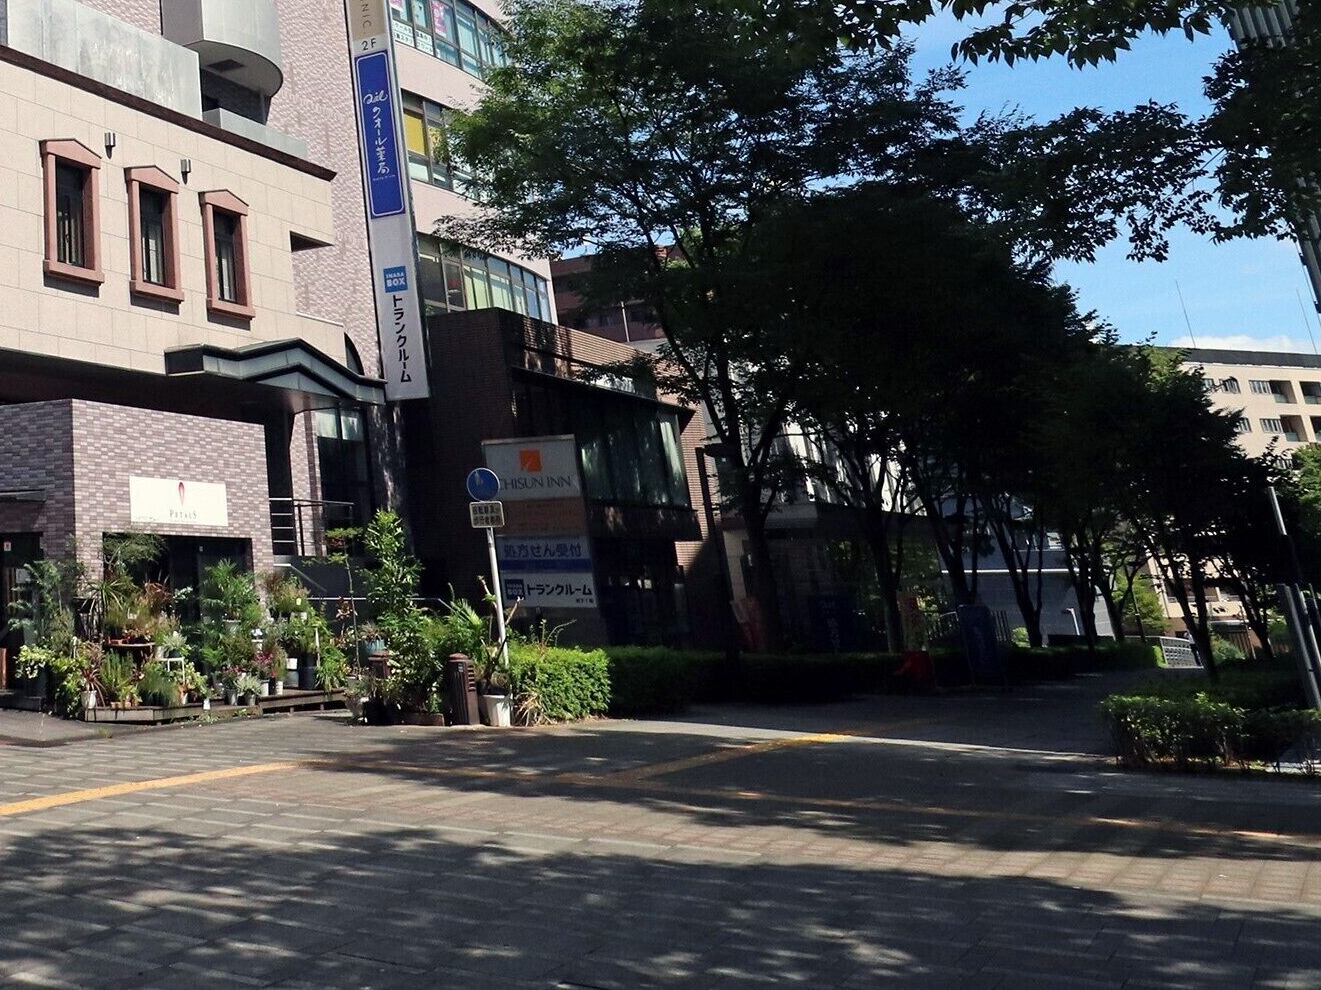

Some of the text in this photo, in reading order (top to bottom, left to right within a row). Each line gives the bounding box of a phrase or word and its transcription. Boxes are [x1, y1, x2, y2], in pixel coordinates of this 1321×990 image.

[361, 37, 377, 51] 2F
[386, 277, 406, 287] BOX
[392, 294, 412, 383] トランクルーム
[547, 475, 572, 488] INN
[503, 543, 582, 558] 処方せん受付
[526, 583, 593, 596] トランクルーム
